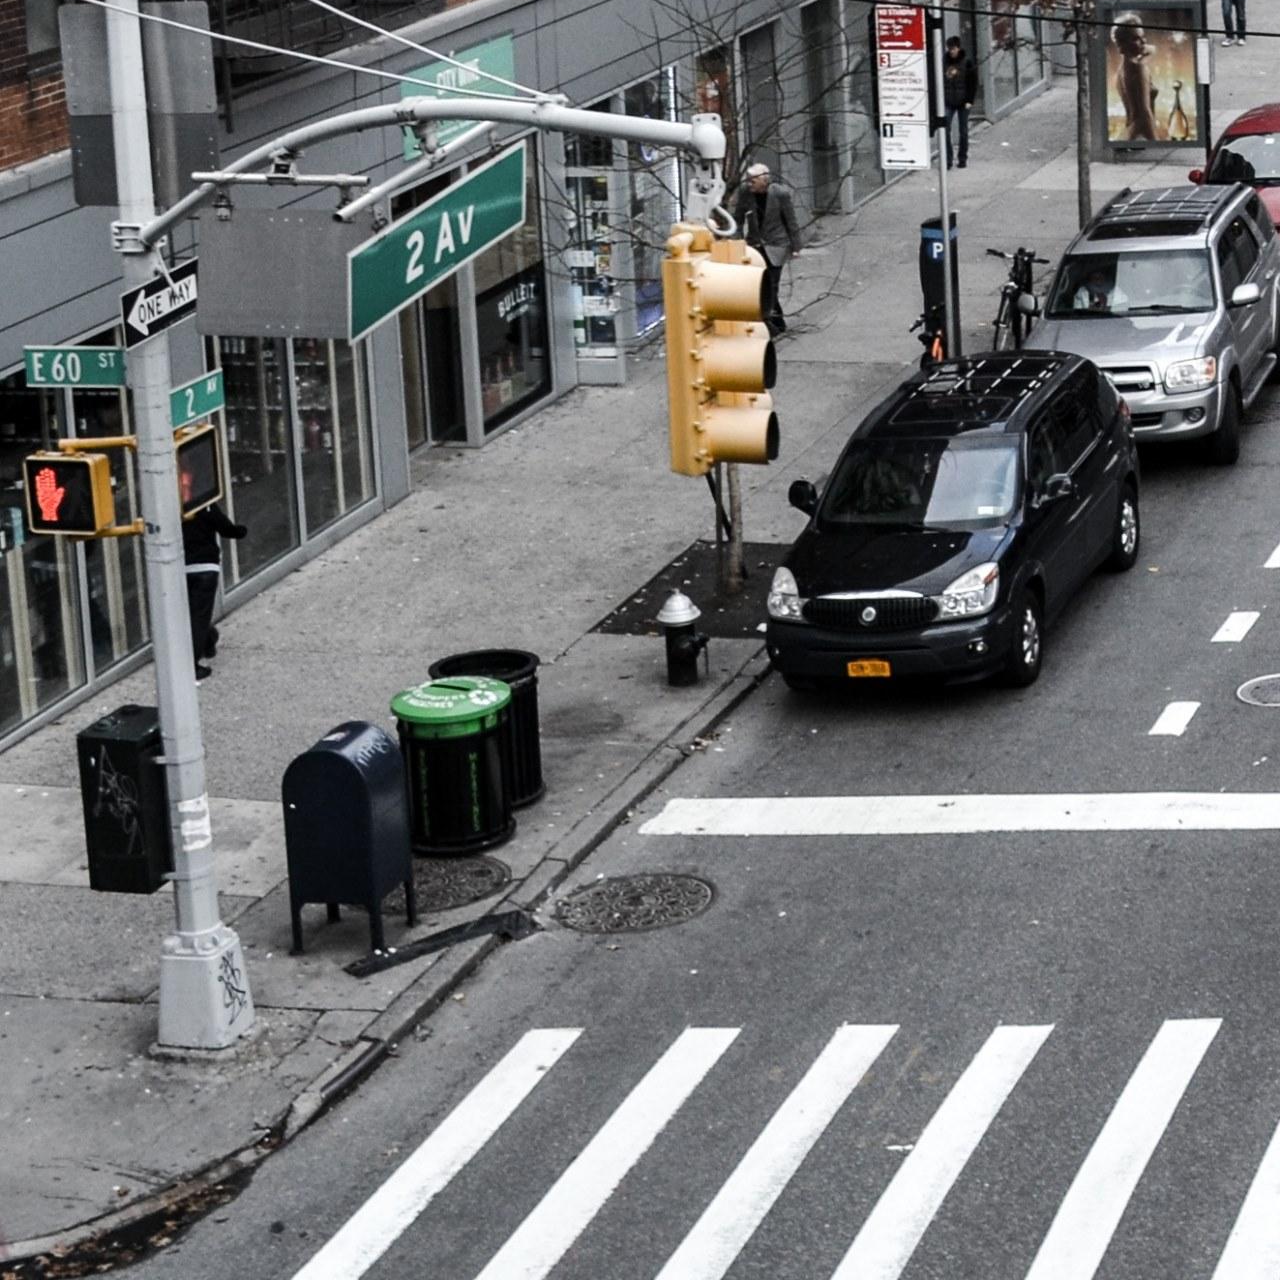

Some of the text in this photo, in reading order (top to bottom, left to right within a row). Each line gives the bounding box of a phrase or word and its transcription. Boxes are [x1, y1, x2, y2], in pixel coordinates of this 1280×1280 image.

[880, 54, 889, 67] 3
[405, 229, 425, 284] 2
[932, 241, 944, 259] P
[137, 278, 193, 324] ONE WAY
[32, 352, 116, 383] E 60 ST
[184, 378, 218, 419] 2 AV
